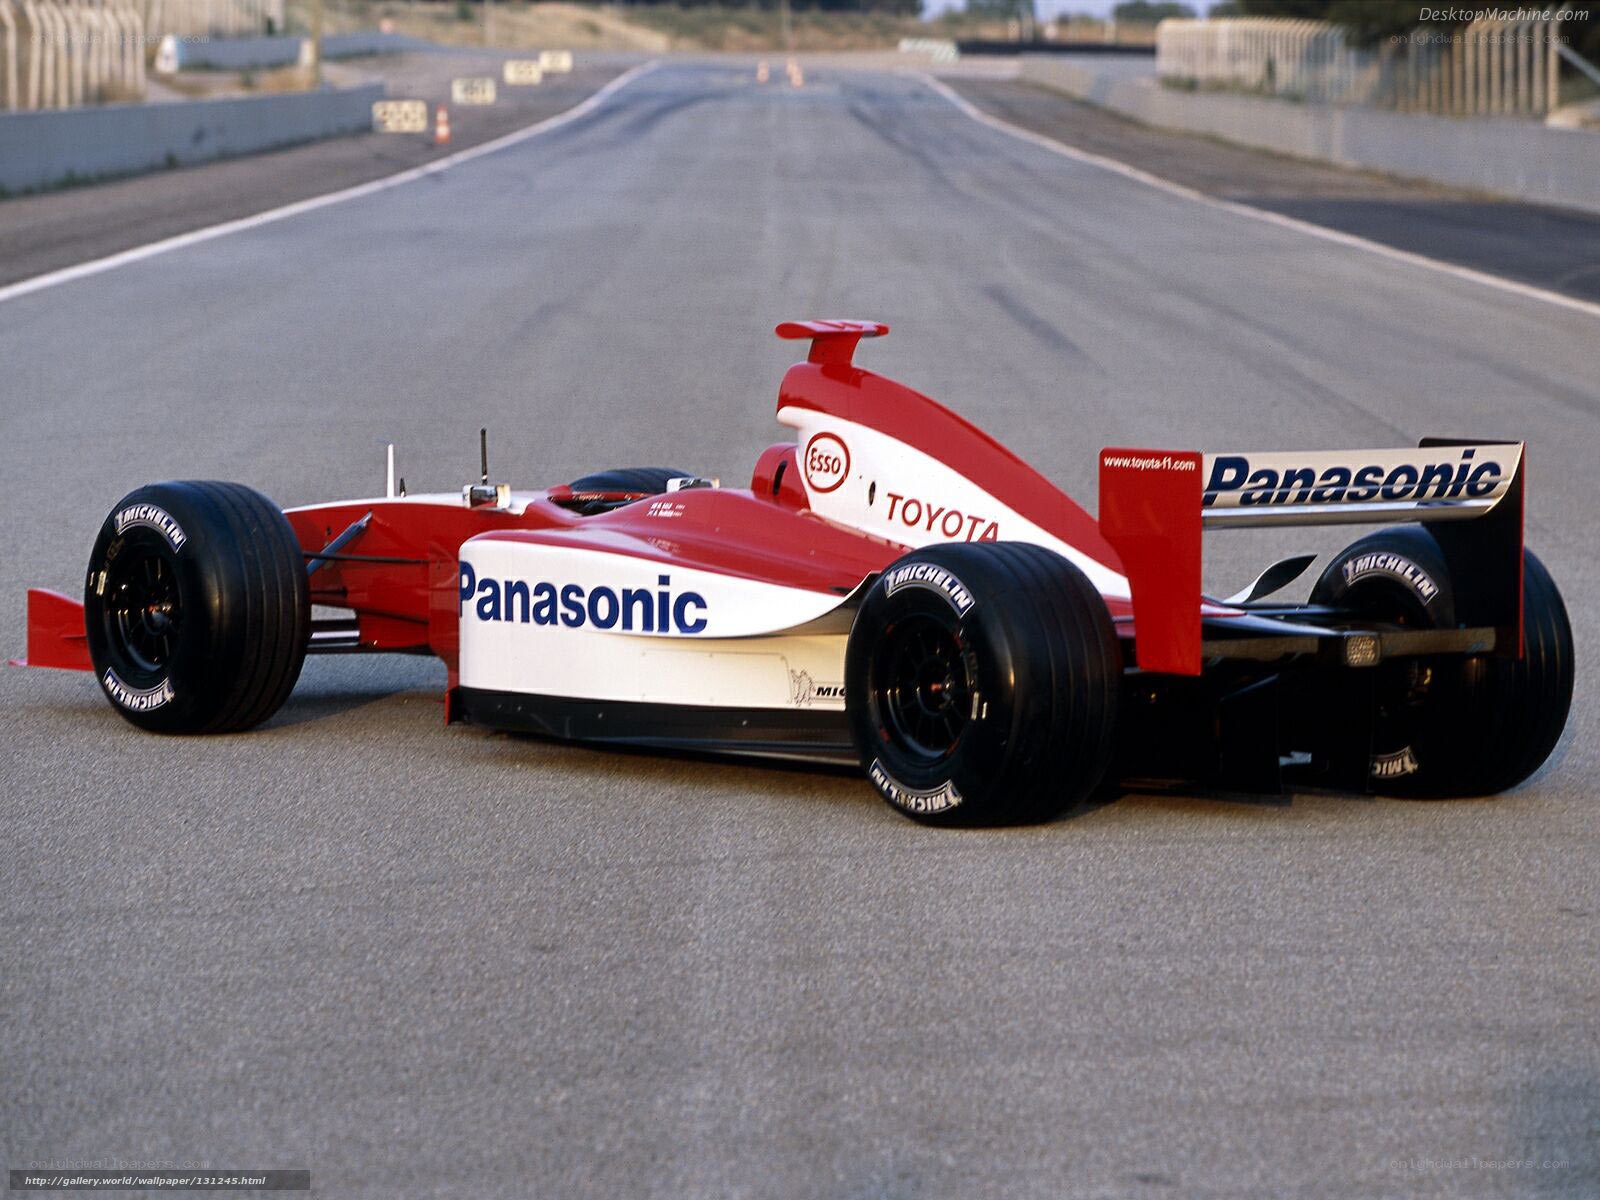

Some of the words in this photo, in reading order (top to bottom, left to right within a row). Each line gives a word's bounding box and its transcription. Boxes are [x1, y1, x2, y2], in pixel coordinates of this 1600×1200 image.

[1103, 456, 1196, 471] www.toyota-f1.com
[1203, 450, 1503, 506] Panasonic
[123, 505, 184, 546] MICHELIN
[886, 493, 1000, 543] TOYOTA
[459, 561, 708, 635] Panasonic
[896, 564, 973, 611] MICHELIN
[1356, 555, 1435, 598] MICHELIN
[106, 677, 168, 709] MICHELIN
